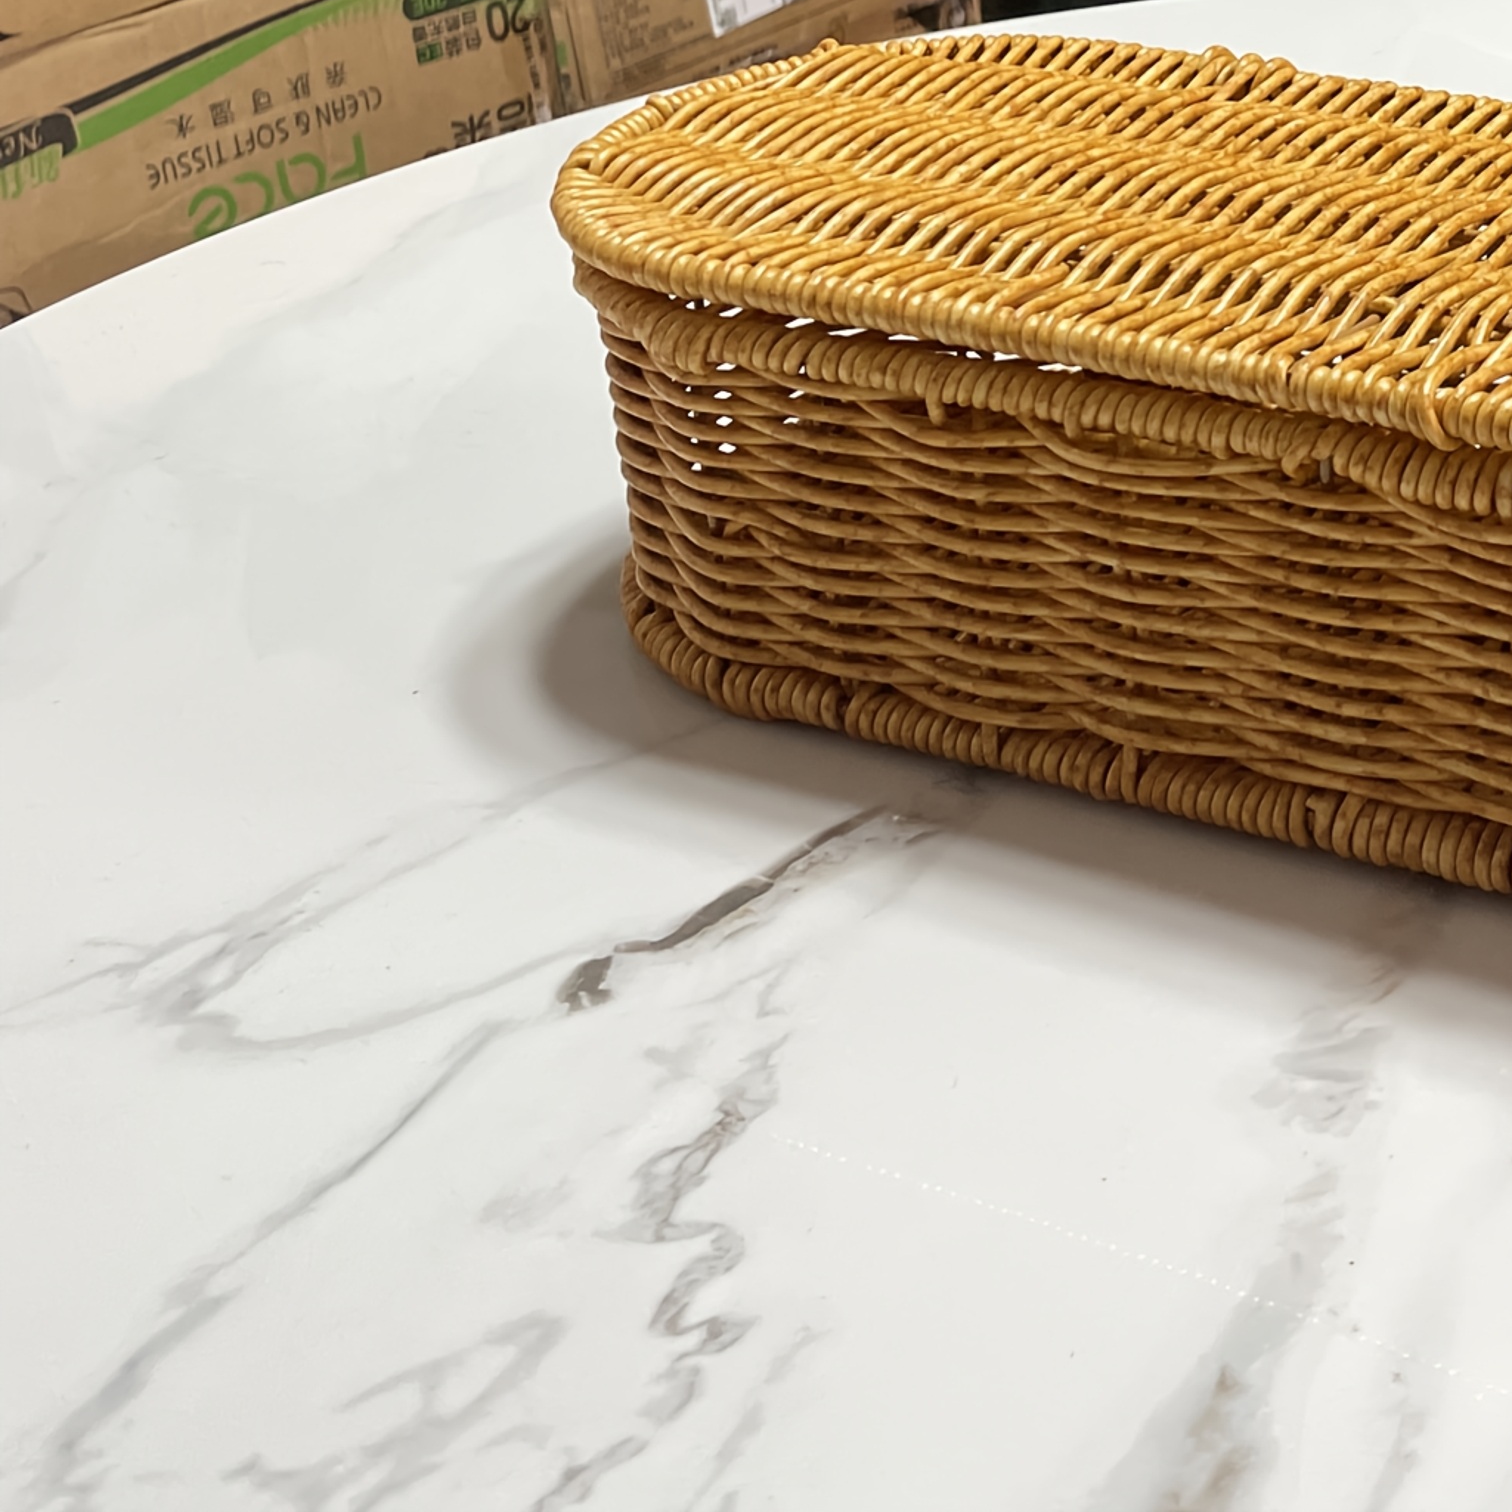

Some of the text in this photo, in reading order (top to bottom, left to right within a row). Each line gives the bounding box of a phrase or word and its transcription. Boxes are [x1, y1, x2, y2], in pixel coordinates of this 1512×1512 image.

[148, 85, 382, 189] CLEAN & SOFT TISSUE
